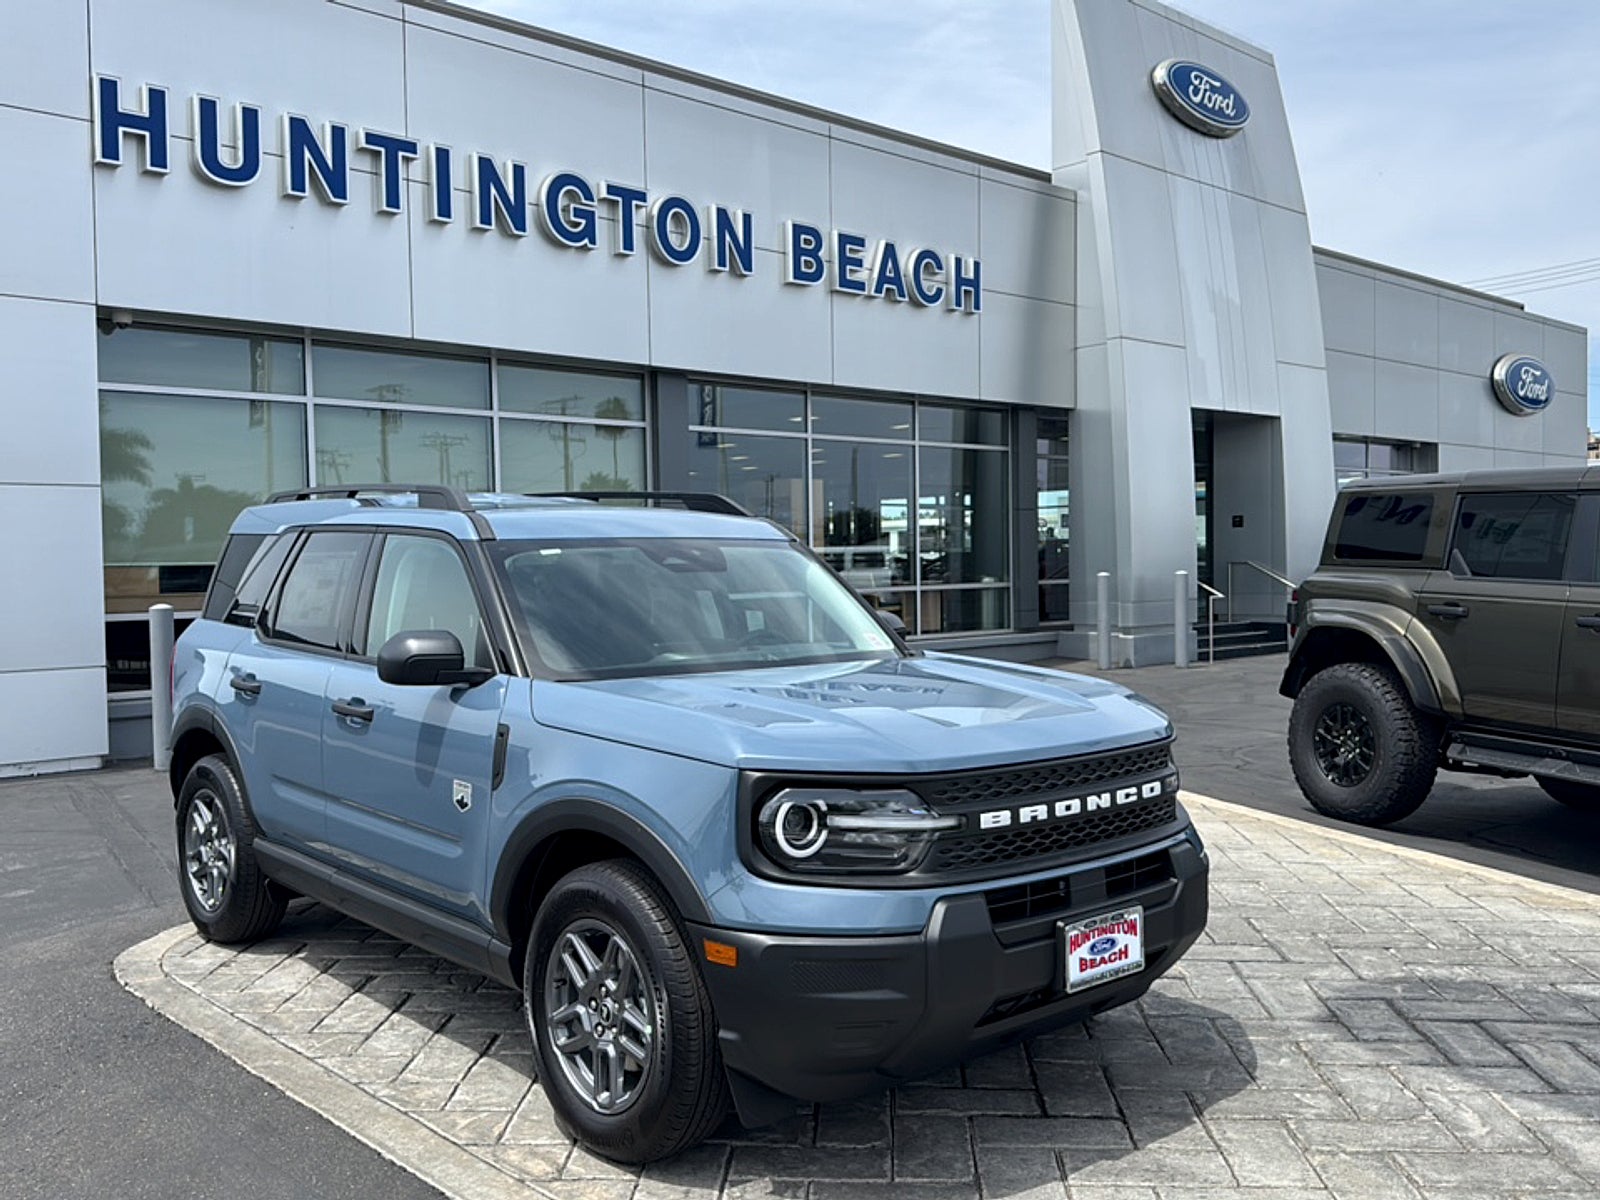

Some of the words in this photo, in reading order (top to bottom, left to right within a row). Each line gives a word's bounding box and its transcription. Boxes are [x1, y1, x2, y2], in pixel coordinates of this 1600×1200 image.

[1188, 71, 1237, 117] Ford
[95, 74, 753, 275] HUNTINGTON
[786, 220, 982, 313] BEACH
[1518, 366, 1548, 401] Ford
[980, 781, 1162, 829] BRONCO
[1070, 917, 1138, 955] HUNTINGTON
[1079, 943, 1129, 973] BEACH
